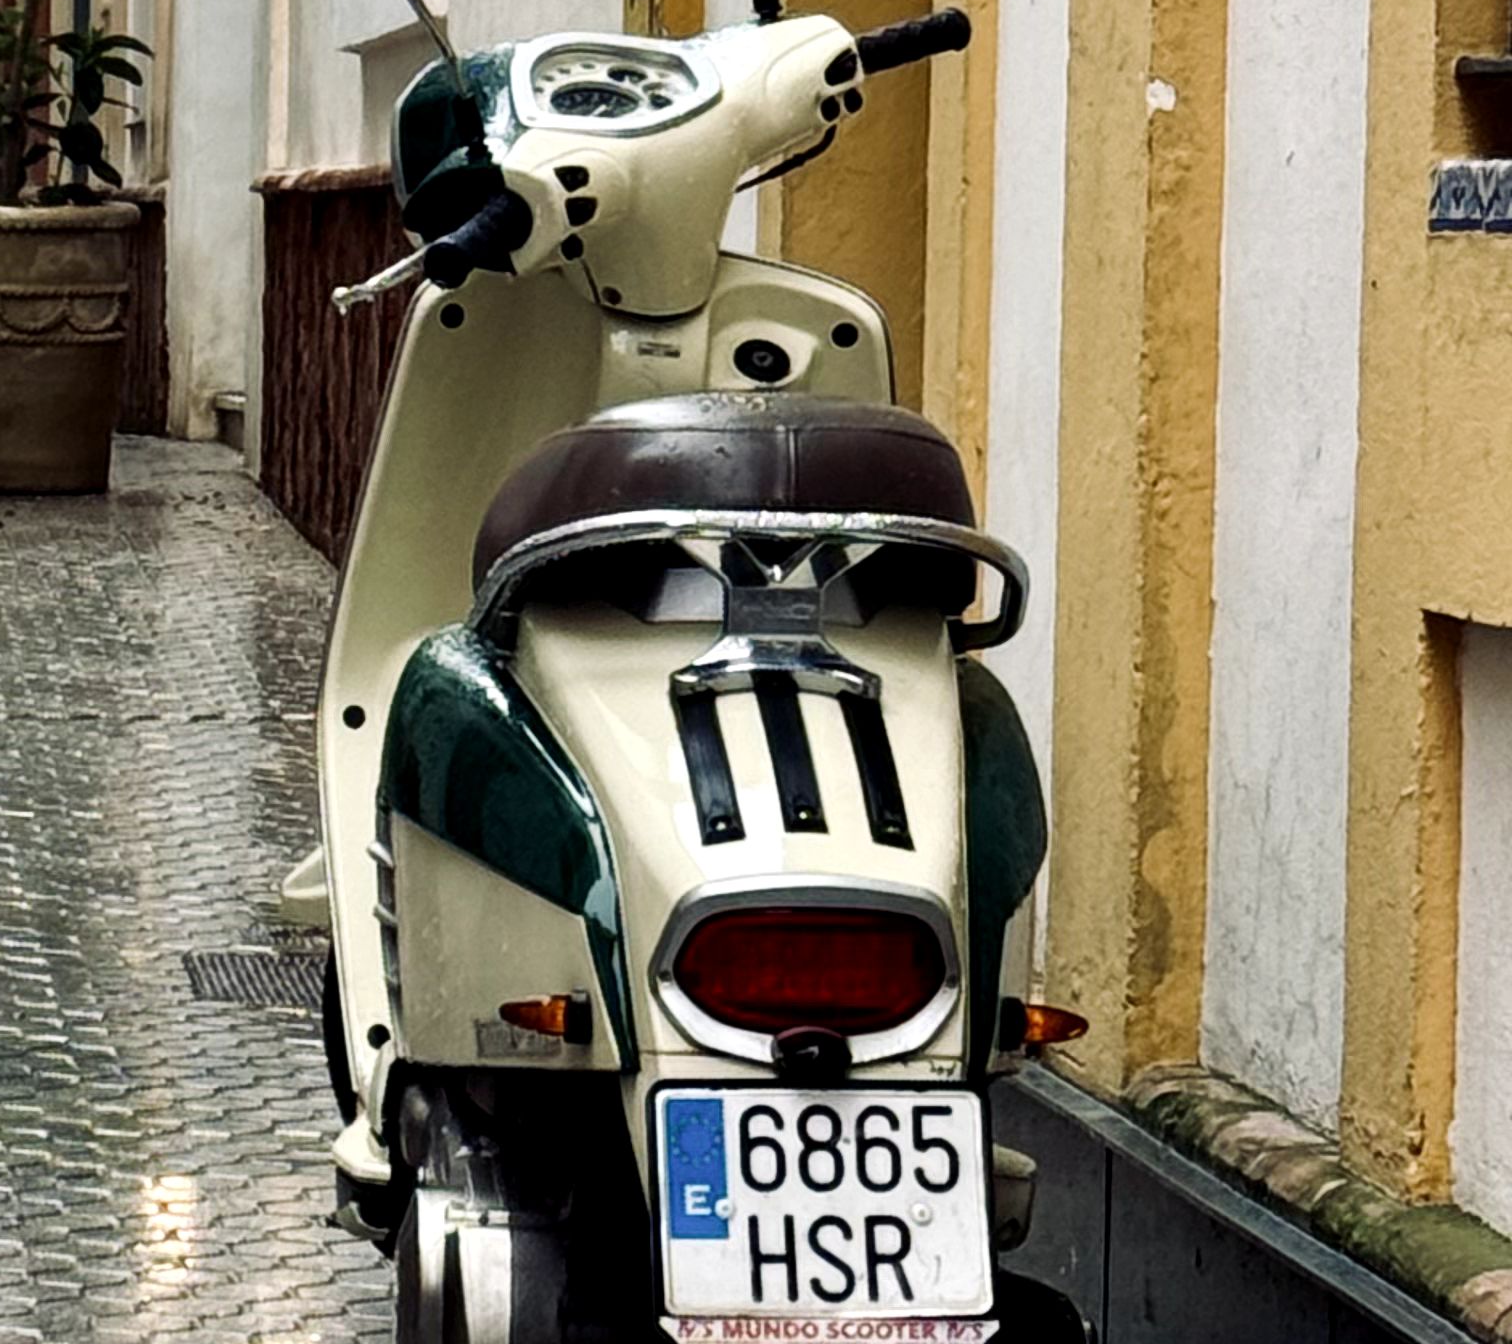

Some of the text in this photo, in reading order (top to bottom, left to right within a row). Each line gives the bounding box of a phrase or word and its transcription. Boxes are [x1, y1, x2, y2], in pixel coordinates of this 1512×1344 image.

[739, 1104, 960, 1193] 6865
[684, 1184, 711, 1215] E
[747, 1214, 914, 1303] HSR
[722, 1320, 819, 1339] MUNDO
[826, 1320, 937, 1340] SCOOTER
